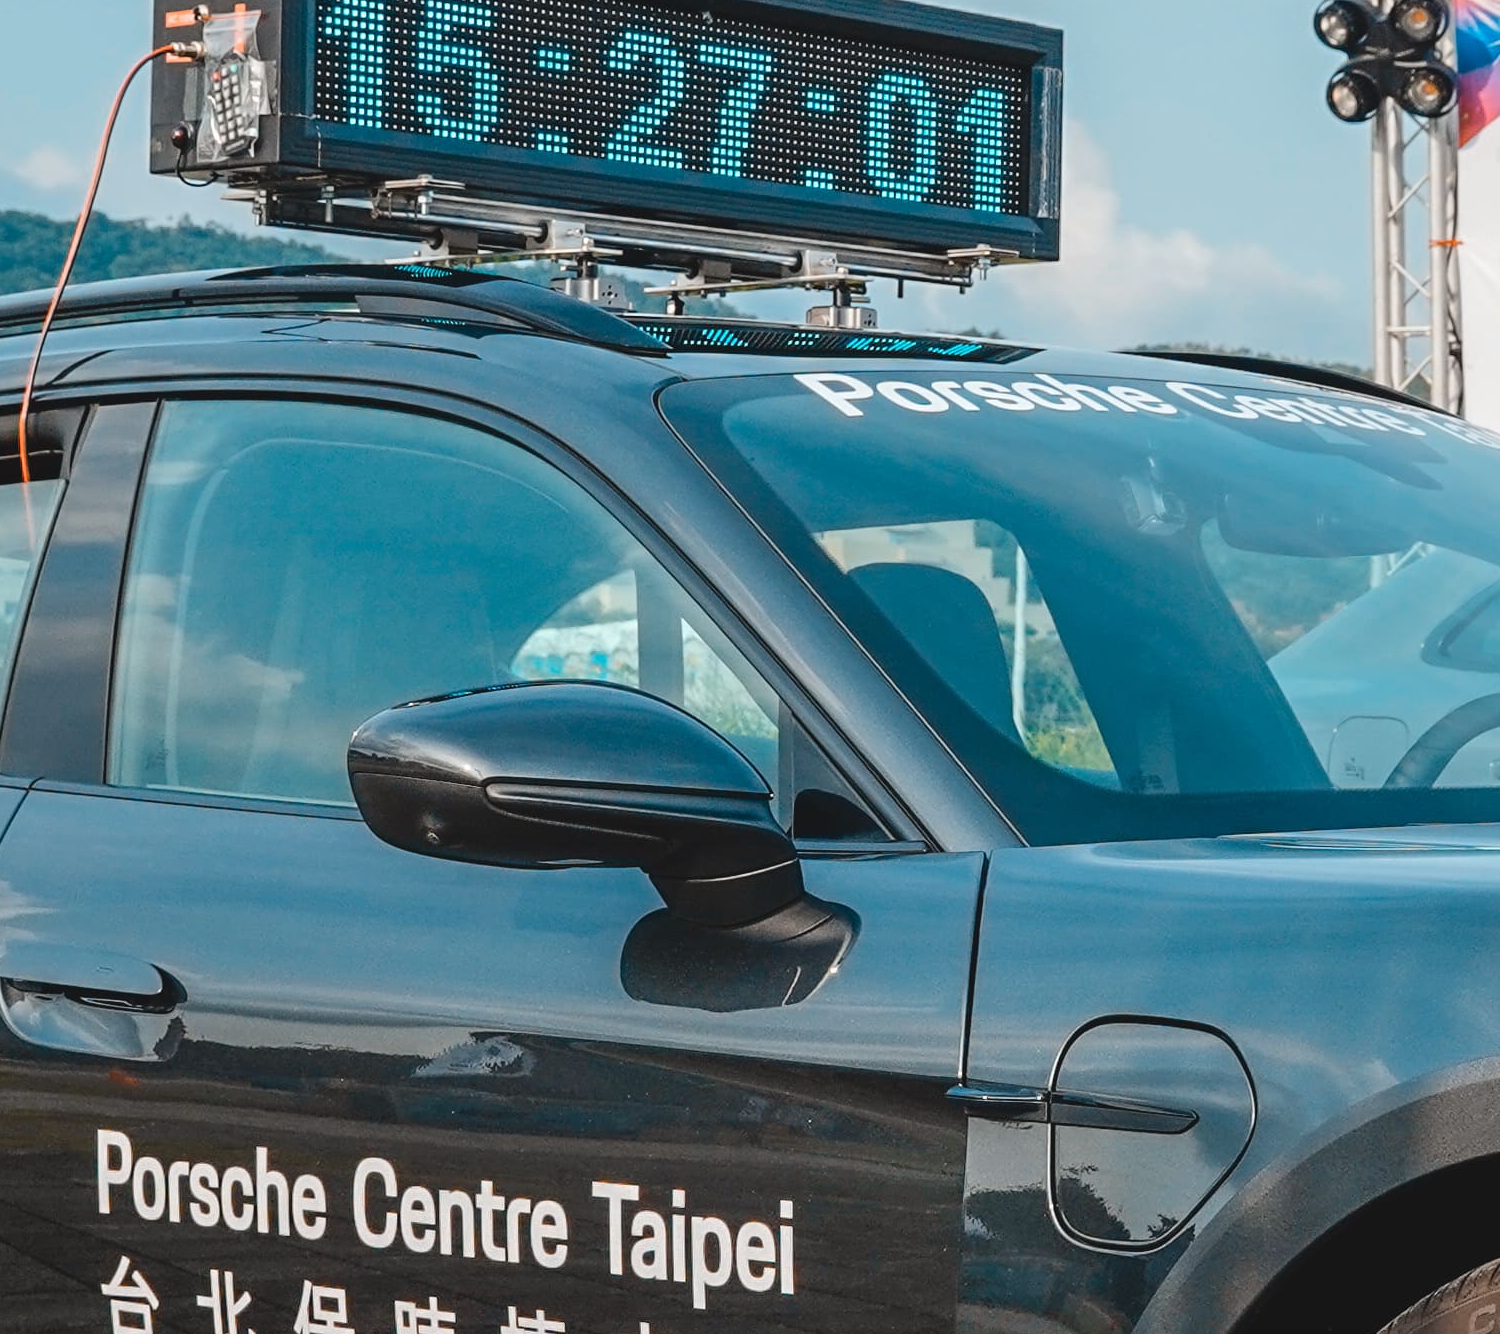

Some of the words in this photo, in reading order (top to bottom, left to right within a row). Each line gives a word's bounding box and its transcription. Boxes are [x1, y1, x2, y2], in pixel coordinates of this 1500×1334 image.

[793, 372, 1181, 417] Porsche
[1164, 380, 1428, 437] Centre
[96, 1129, 328, 1244] Porsche
[353, 1155, 569, 1270] Centre
[591, 1181, 796, 1310] Taipei
